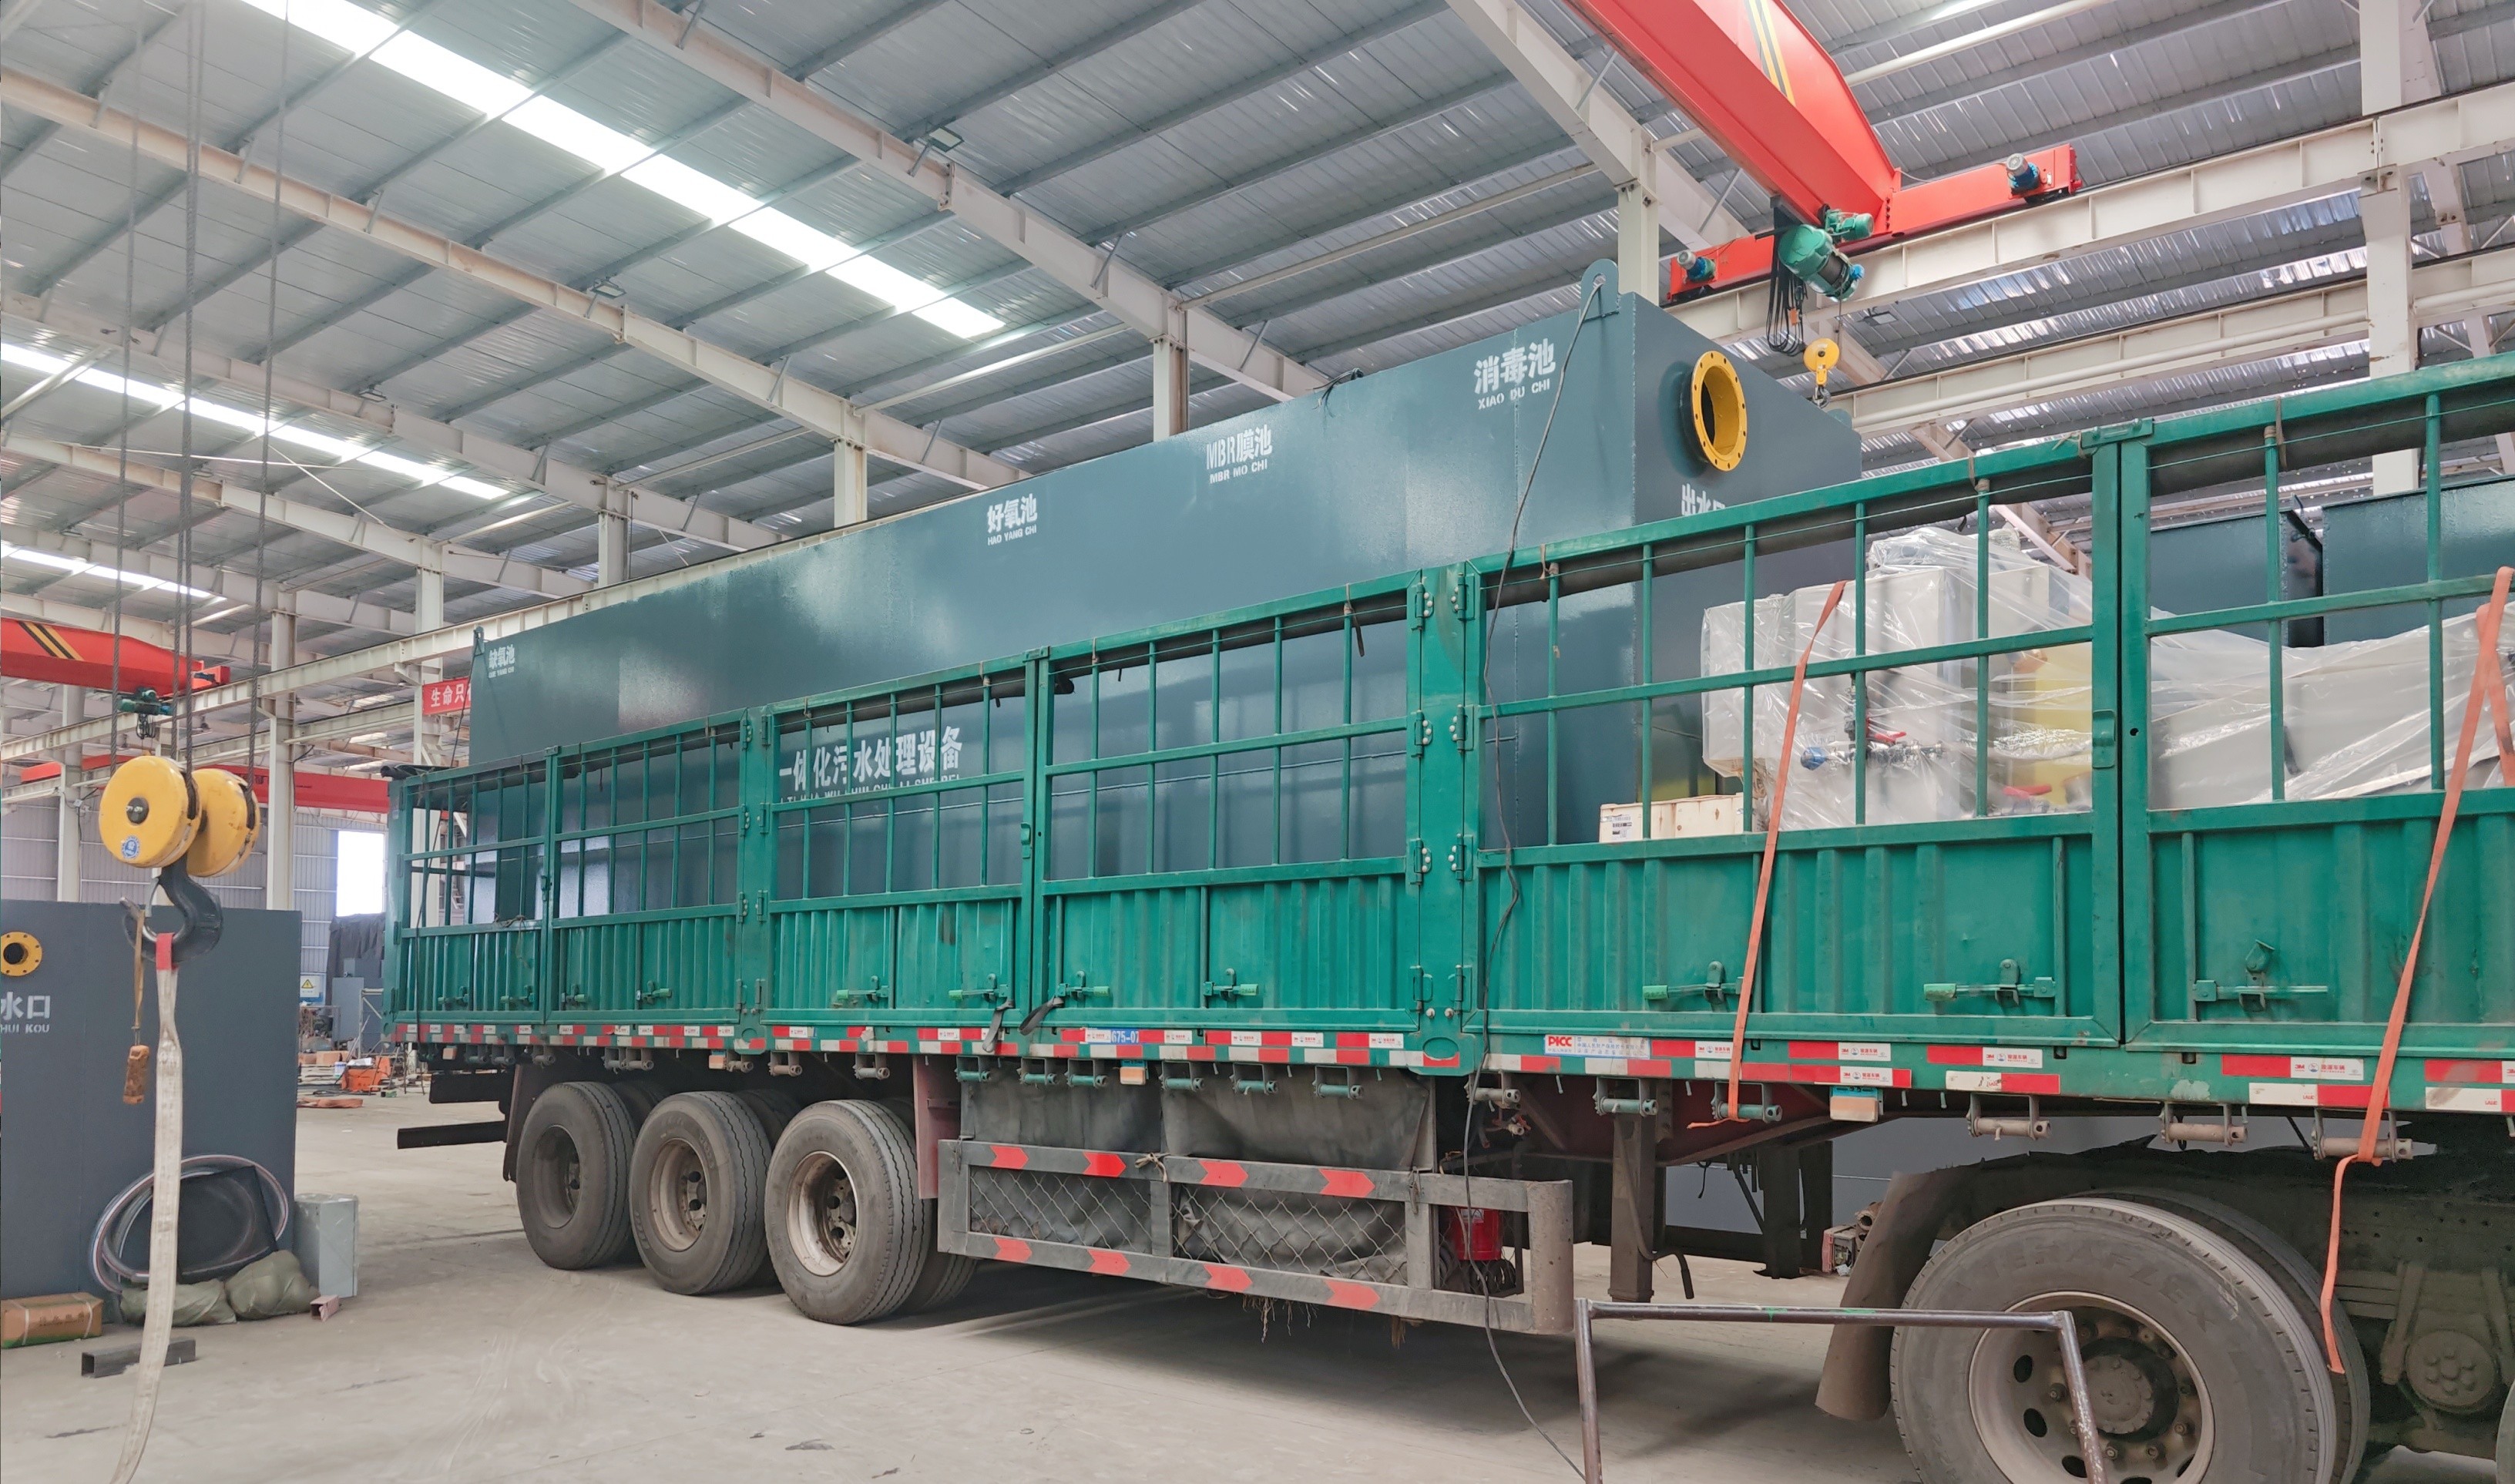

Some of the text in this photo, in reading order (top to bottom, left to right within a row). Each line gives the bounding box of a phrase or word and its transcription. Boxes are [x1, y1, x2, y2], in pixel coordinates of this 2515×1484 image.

[1473, 337, 1556, 394] 消毒池
[1478, 378, 1550, 410] XIAO DU CHI
[1206, 424, 1273, 470] MBR膜池
[1210, 458, 1268, 484] MBR MO CHI
[987, 493, 1038, 533] 好氧池
[987, 524, 1037, 546] HAO YANG CHI
[489, 643, 515, 670] 缺氧池
[25, 1023, 51, 1034] KOU
[1548, 1036, 1572, 1047] PICC
